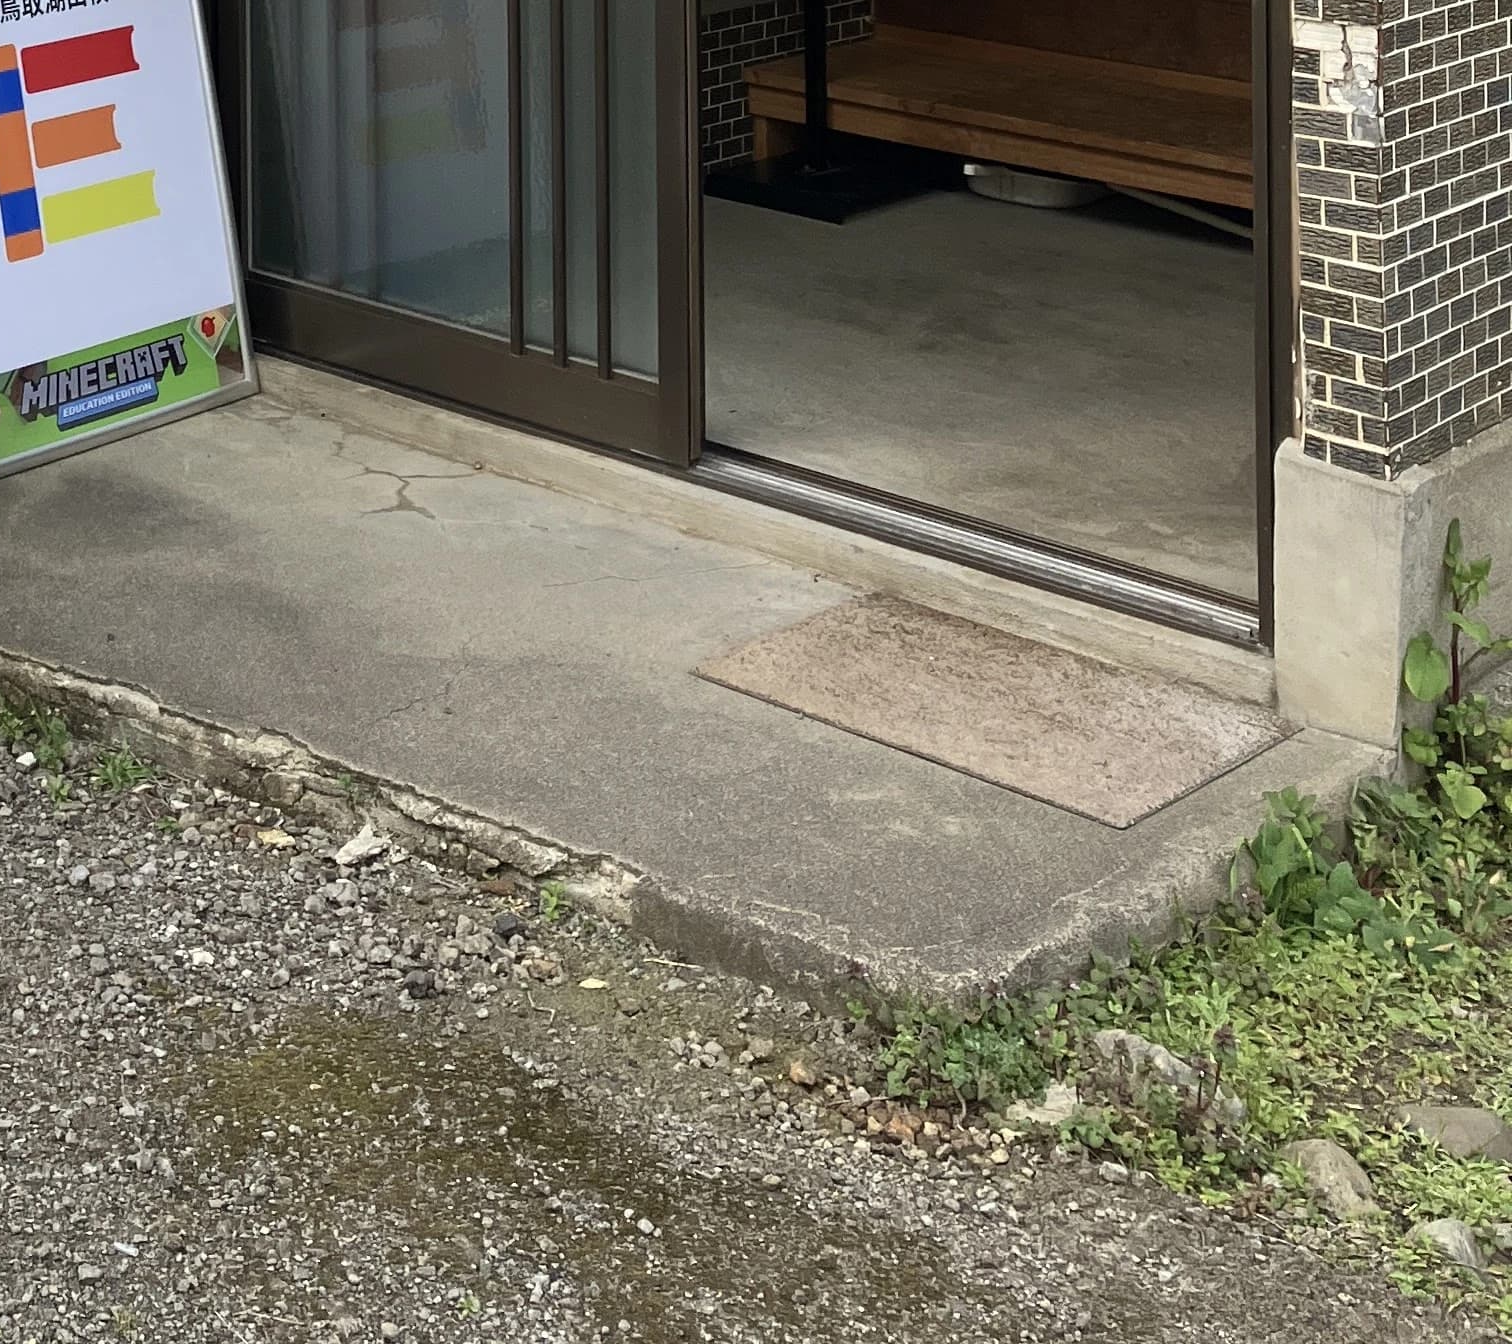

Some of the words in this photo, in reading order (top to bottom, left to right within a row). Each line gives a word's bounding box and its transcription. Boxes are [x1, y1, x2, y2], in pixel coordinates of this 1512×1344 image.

[19, 334, 188, 422] MINECRAFT
[63, 395, 115, 418] EDUCATION
[115, 382, 152, 402] EDITION
